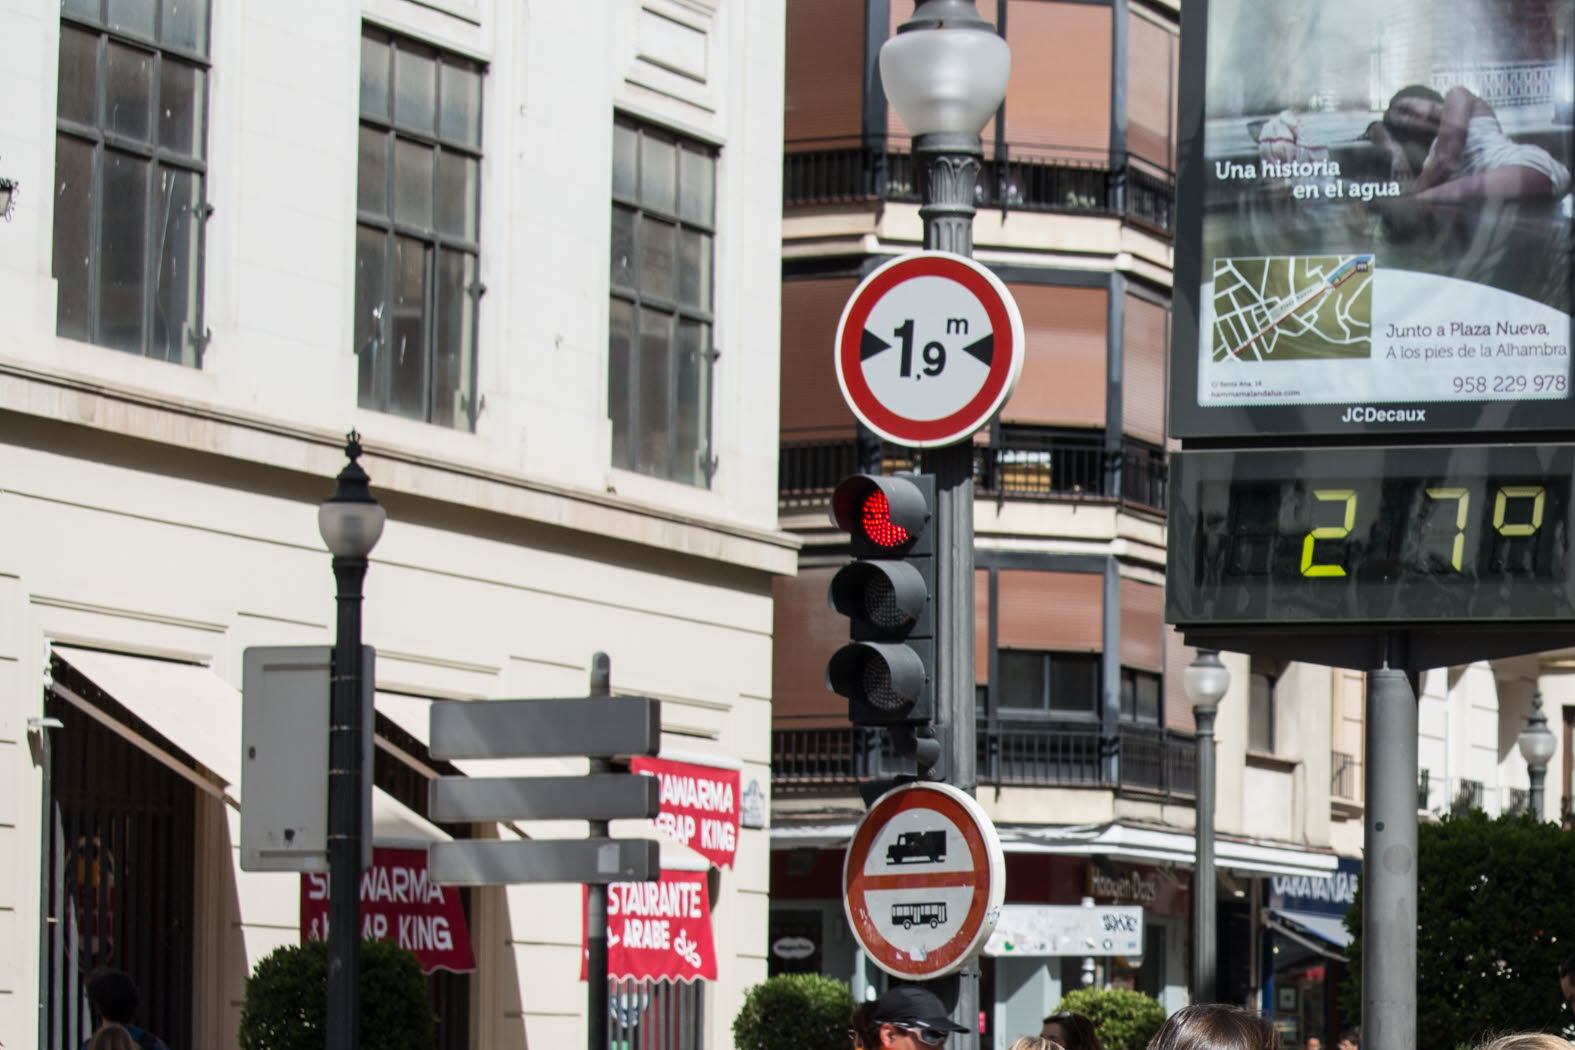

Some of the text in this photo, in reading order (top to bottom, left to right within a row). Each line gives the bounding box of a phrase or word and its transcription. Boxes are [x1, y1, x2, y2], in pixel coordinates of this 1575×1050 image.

[1215, 160, 1341, 180] Una historia
[1293, 180, 1400, 202] en el agua
[946, 318, 969, 335] m
[1386, 321, 1551, 339] Junto a Plaza Nueva,
[1386, 342, 1568, 362] A los pies de la Alhambra
[1452, 374, 1567, 394] 958 229 978
[1342, 406, 1426, 423] JCDecaux
[701, 818, 735, 851] KING
[309, 866, 445, 904] SWARMA
[607, 882, 702, 918] STAURANTE
[398, 914, 453, 951] KING
[623, 919, 670, 950] ARABE
